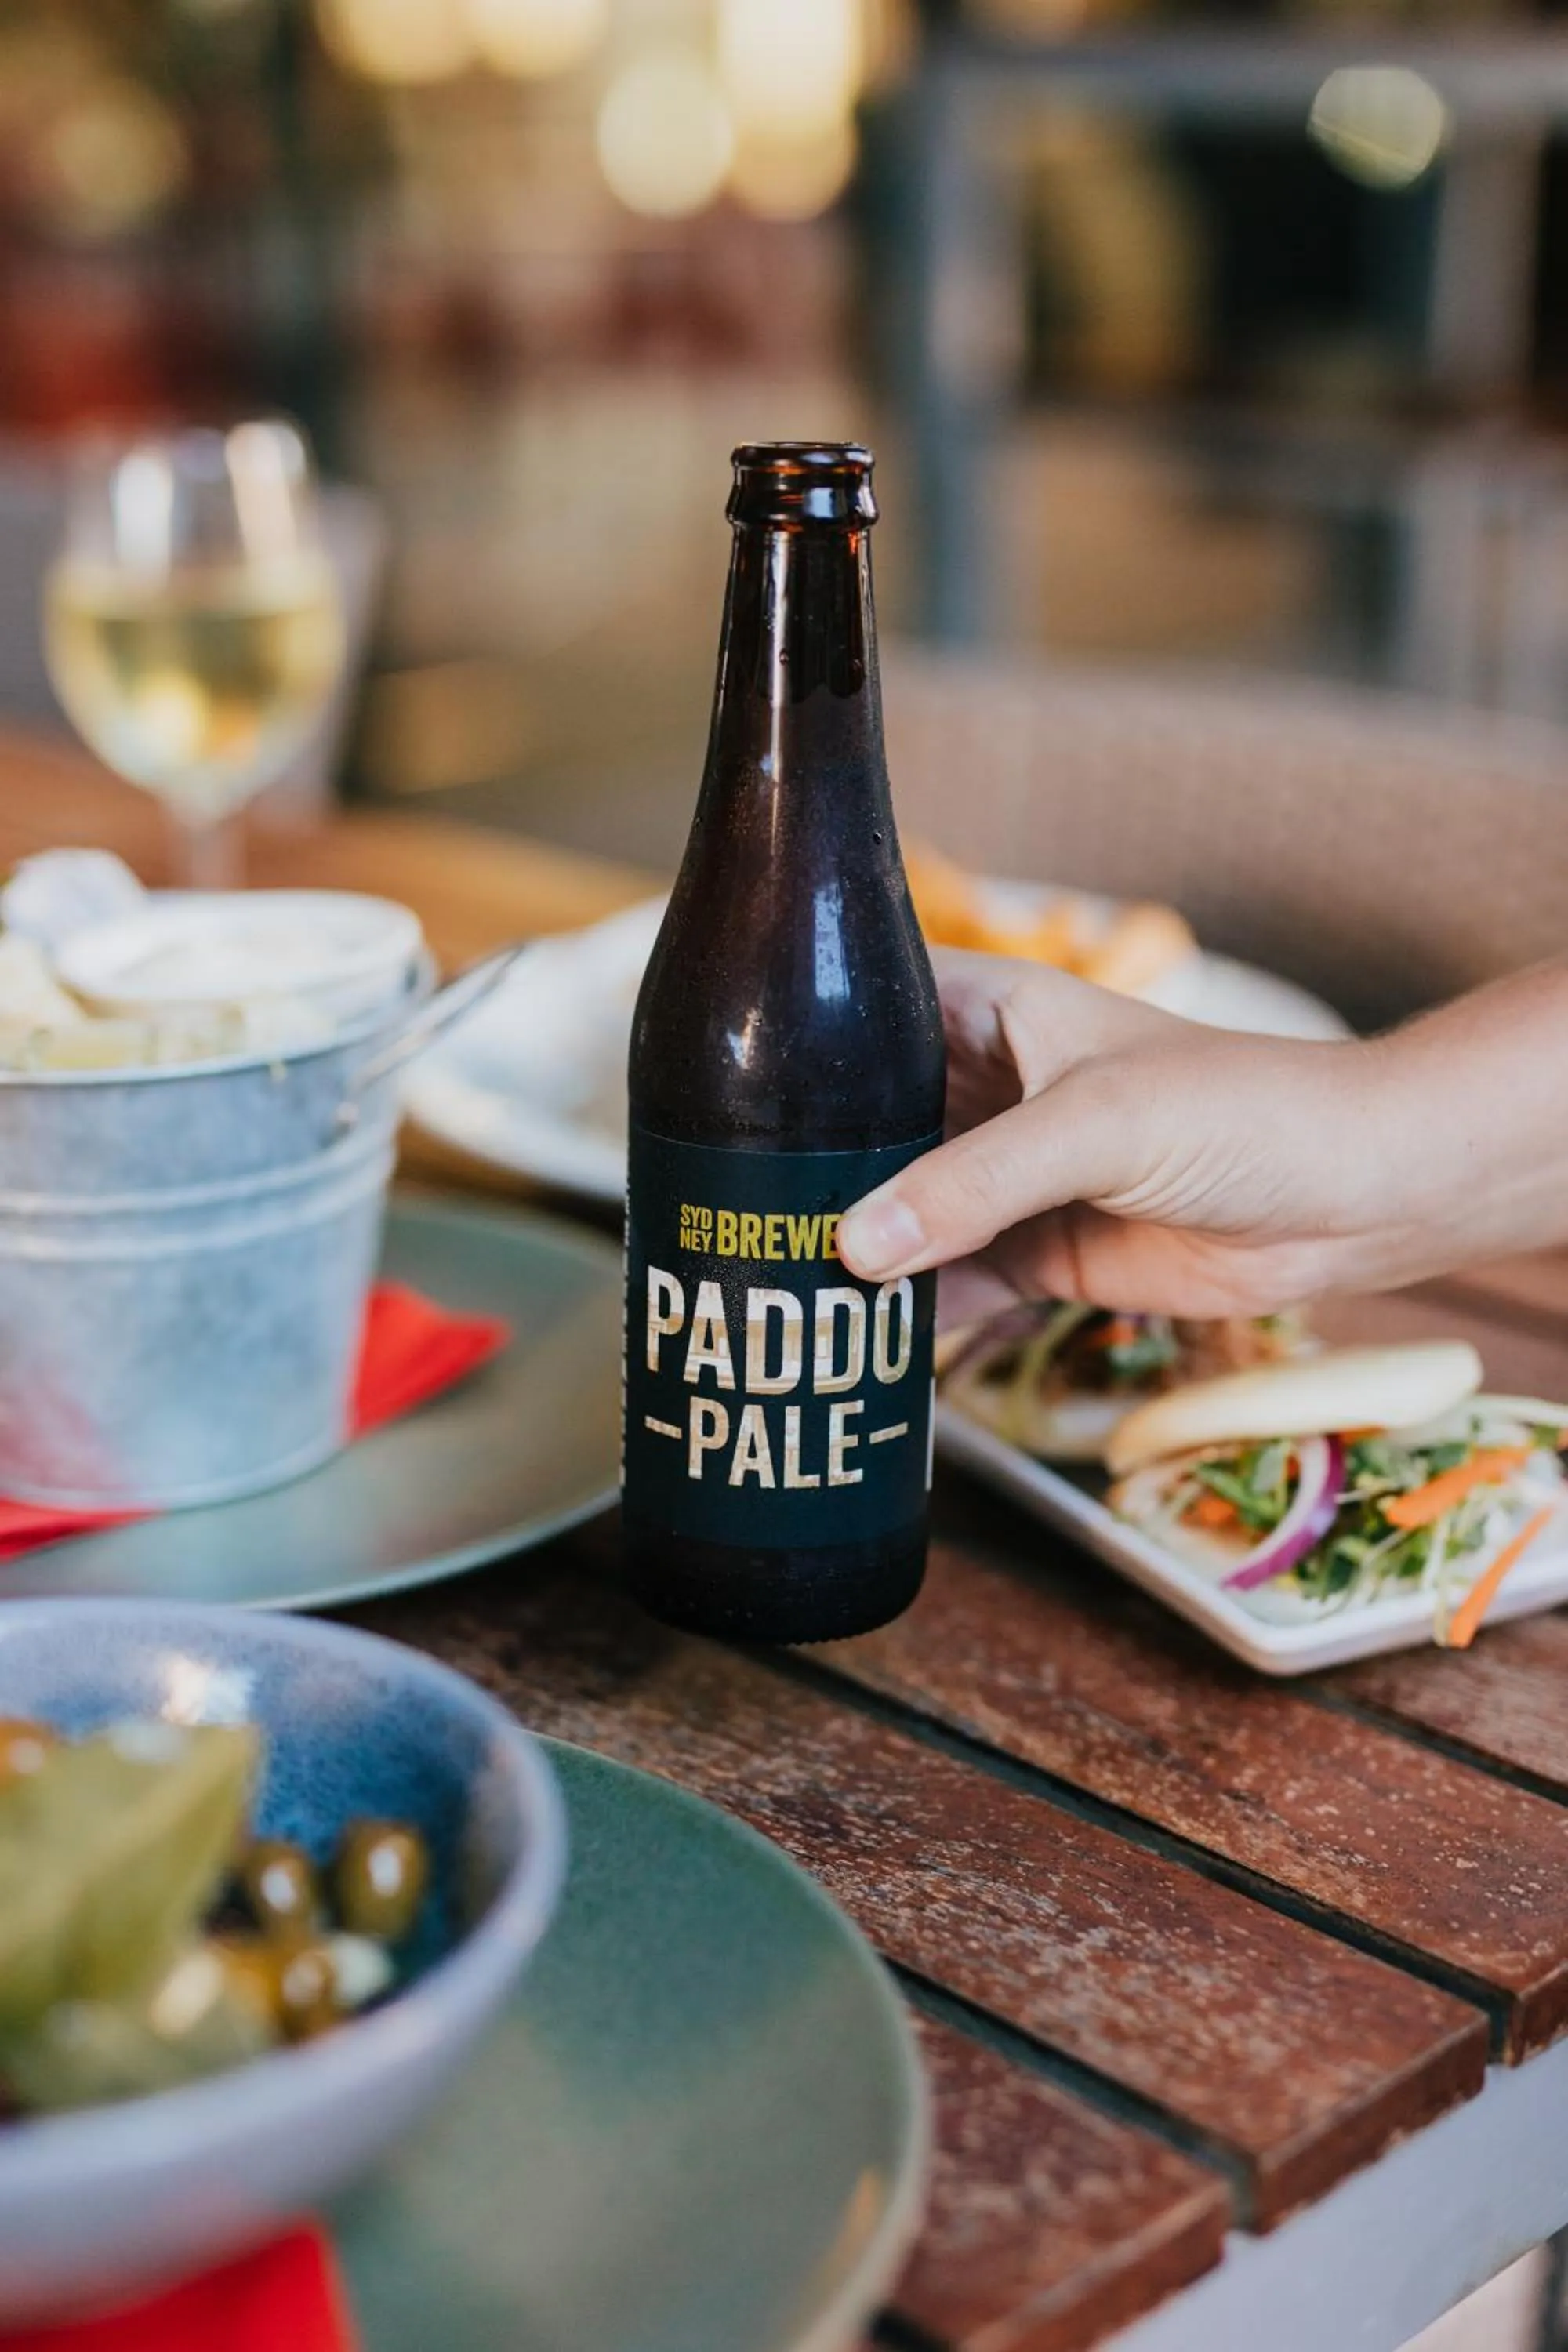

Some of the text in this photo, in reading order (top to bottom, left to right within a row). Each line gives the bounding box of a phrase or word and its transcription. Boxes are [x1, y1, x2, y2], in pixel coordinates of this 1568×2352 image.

[680, 1203, 713, 1230] SYD
[717, 1210, 841, 1260] BREWE
[680, 1226, 713, 1253] NEY
[647, 1265, 913, 1395] PADDO
